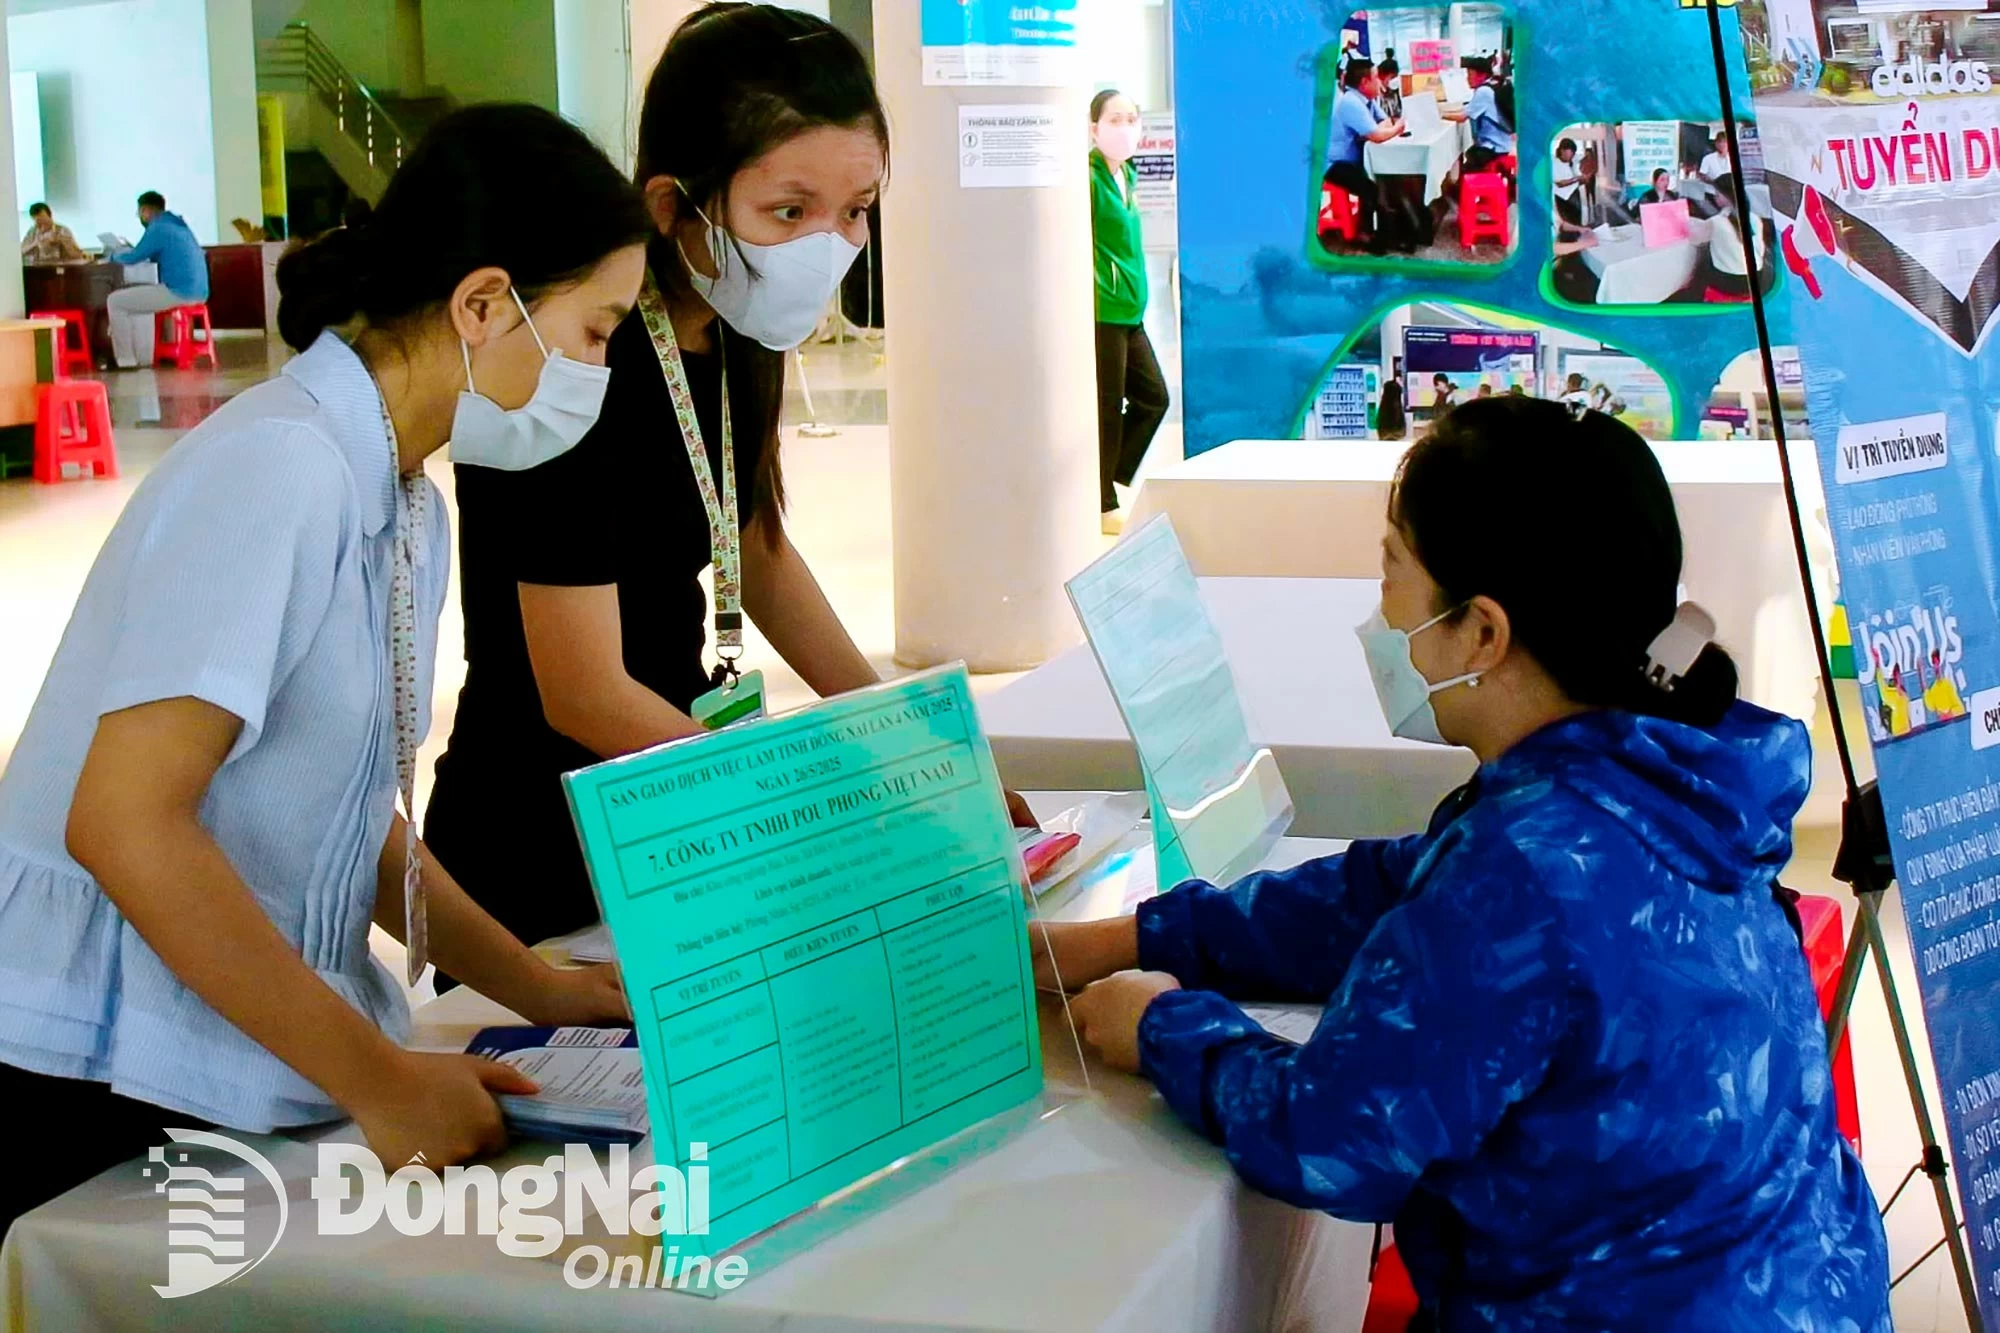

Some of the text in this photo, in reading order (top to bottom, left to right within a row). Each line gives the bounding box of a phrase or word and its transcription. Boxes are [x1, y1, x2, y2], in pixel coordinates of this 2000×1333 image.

[1872, 50, 1992, 97] adidas
[1827, 102, 1952, 191] TUYỂN
[1842, 428, 1945, 475] VỊ TRÍ TUYỂN DỤNG
[610, 786, 638, 809] SÀN
[640, 777, 676, 801] GIAO
[677, 770, 713, 793] DỊCH
[712, 757, 745, 781] VIỆC
[745, 748, 776, 769] LÀM
[776, 738, 809, 761] TỈNH
[808, 730, 846, 752] ĐỒNG
[846, 721, 869, 738] NAI
[756, 770, 791, 791] NGÀY
[648, 759, 955, 874] 7. CÔNG TY TNHH POU PHONG VIỆT NAM
